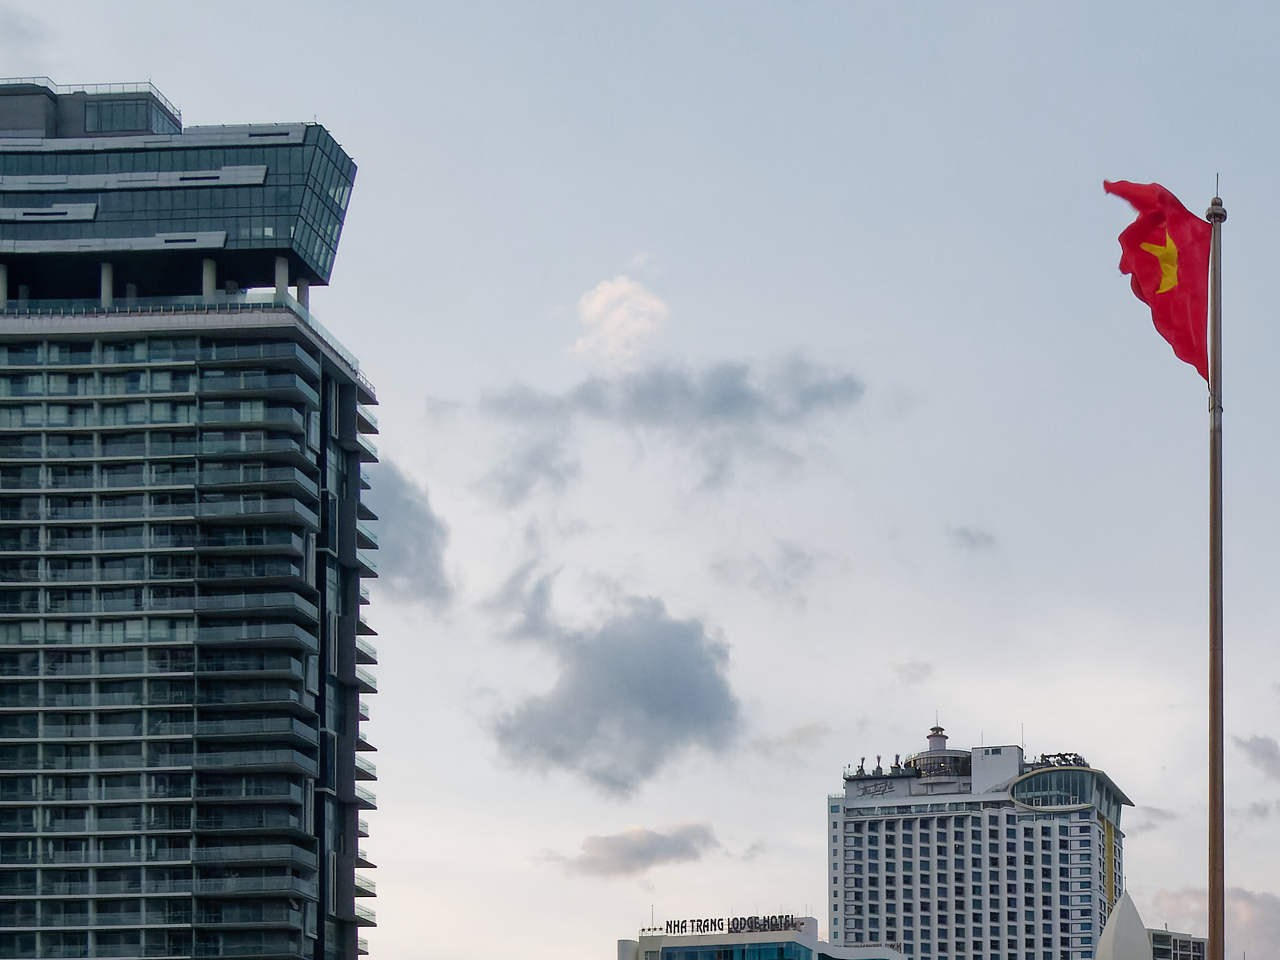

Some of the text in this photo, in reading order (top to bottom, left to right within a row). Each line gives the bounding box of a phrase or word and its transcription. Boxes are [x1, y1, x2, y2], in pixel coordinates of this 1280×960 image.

[666, 915, 795, 934] NHA TRANG LODGE HOTEL
